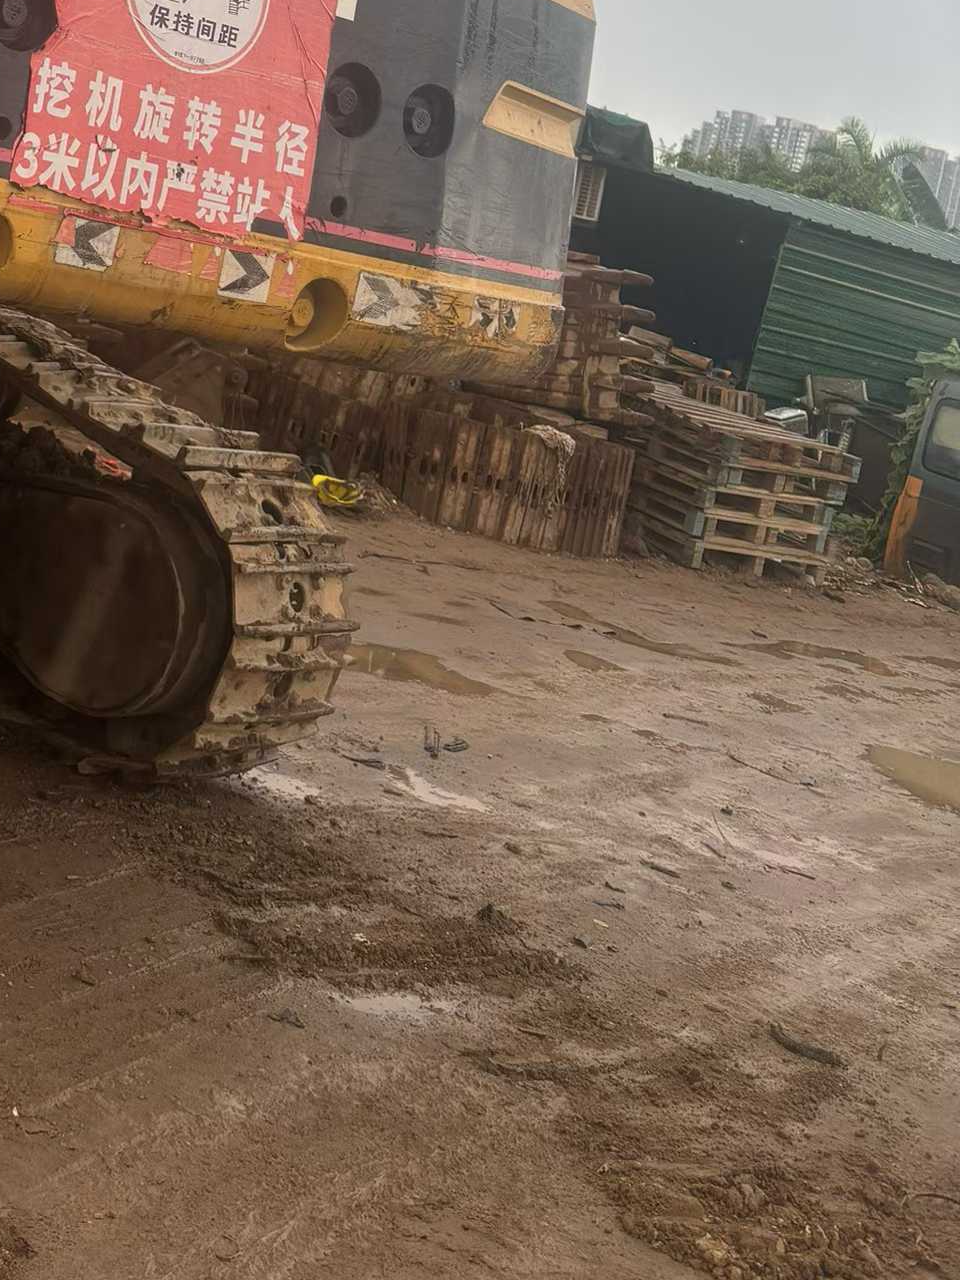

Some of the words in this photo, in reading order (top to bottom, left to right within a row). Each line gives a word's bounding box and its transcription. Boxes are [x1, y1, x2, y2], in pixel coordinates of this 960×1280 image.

[149, 3, 240, 48] 保持间距
[33, 57, 310, 177] 挖机旋转半径
